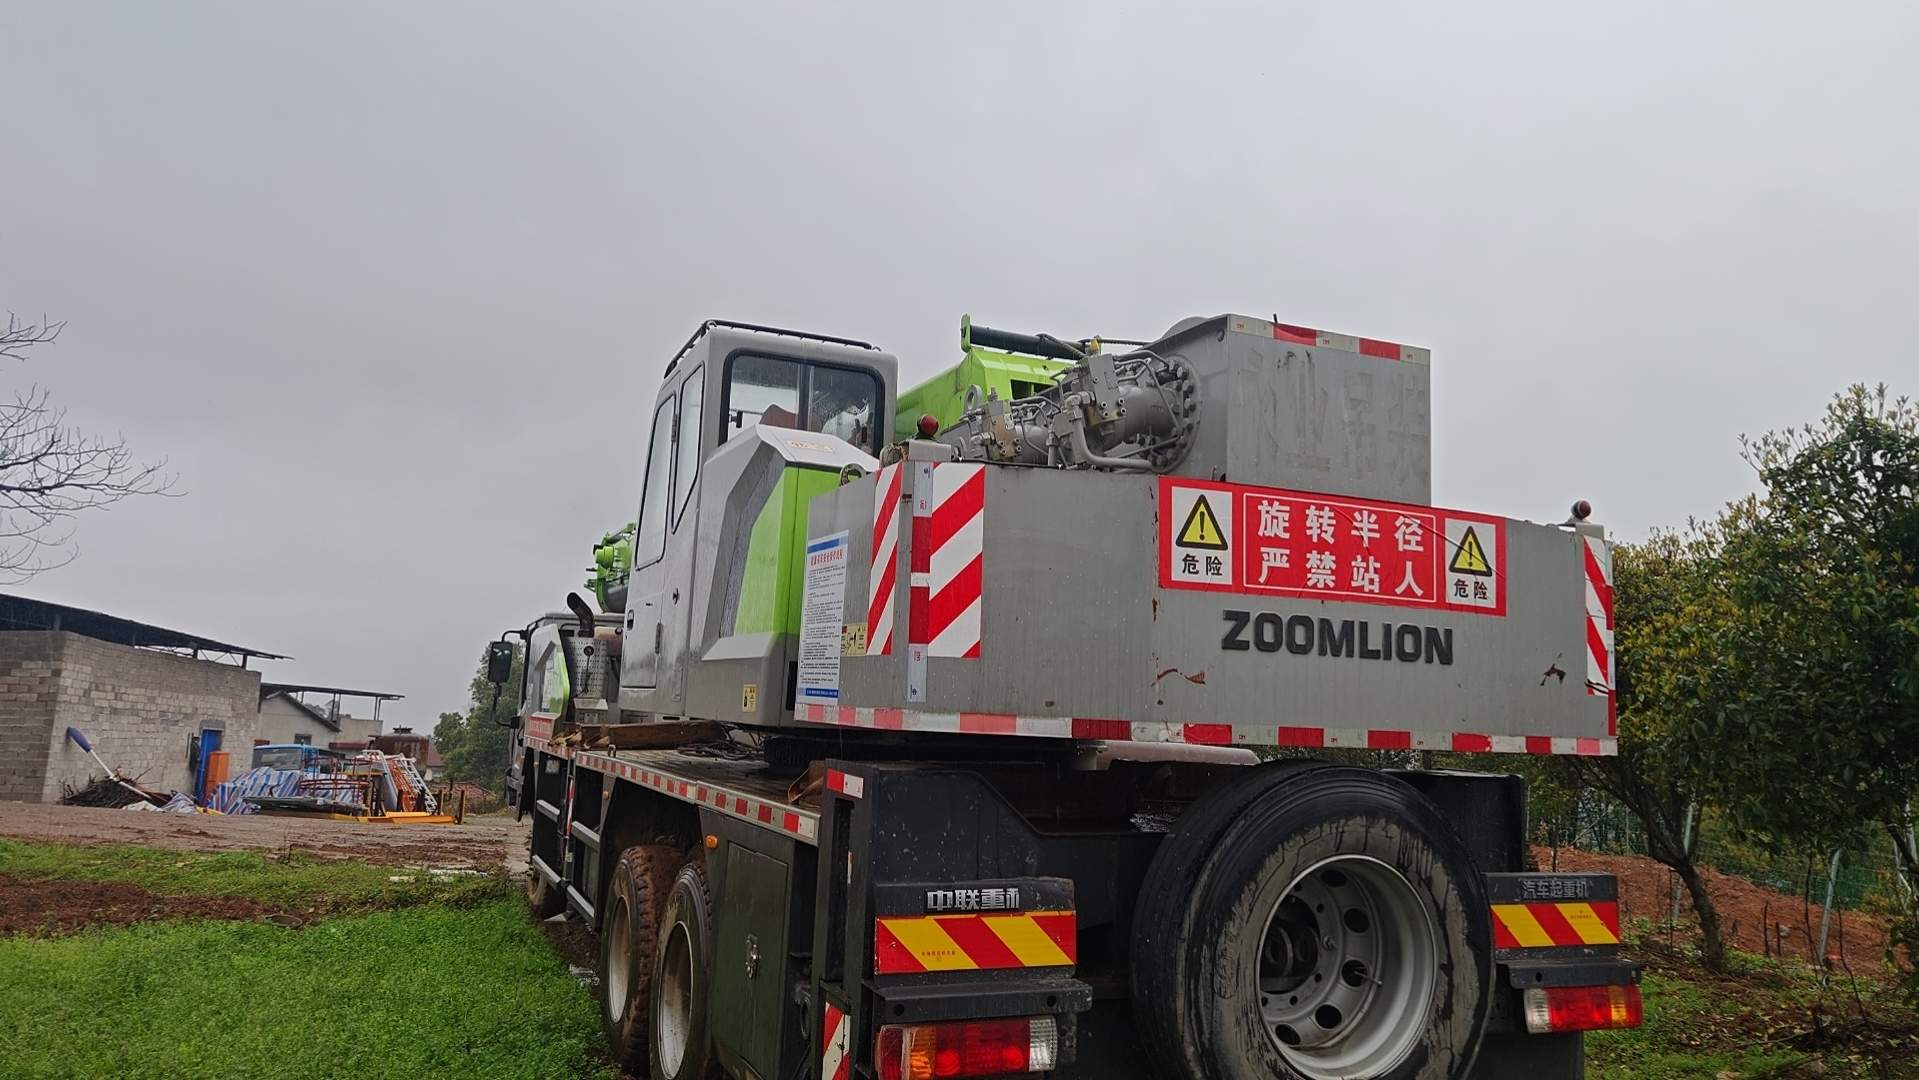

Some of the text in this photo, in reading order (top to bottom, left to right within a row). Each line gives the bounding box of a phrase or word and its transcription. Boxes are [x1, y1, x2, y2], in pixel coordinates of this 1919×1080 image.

[1257, 499, 1425, 553] 旋转半径
[1181, 552, 1223, 576] 危险
[1257, 546, 1425, 597] 严禁站人
[1453, 578, 1489, 600] 危险
[1221, 609, 1454, 666] ZOOMLION
[1521, 878, 1589, 899] 汽车起重机
